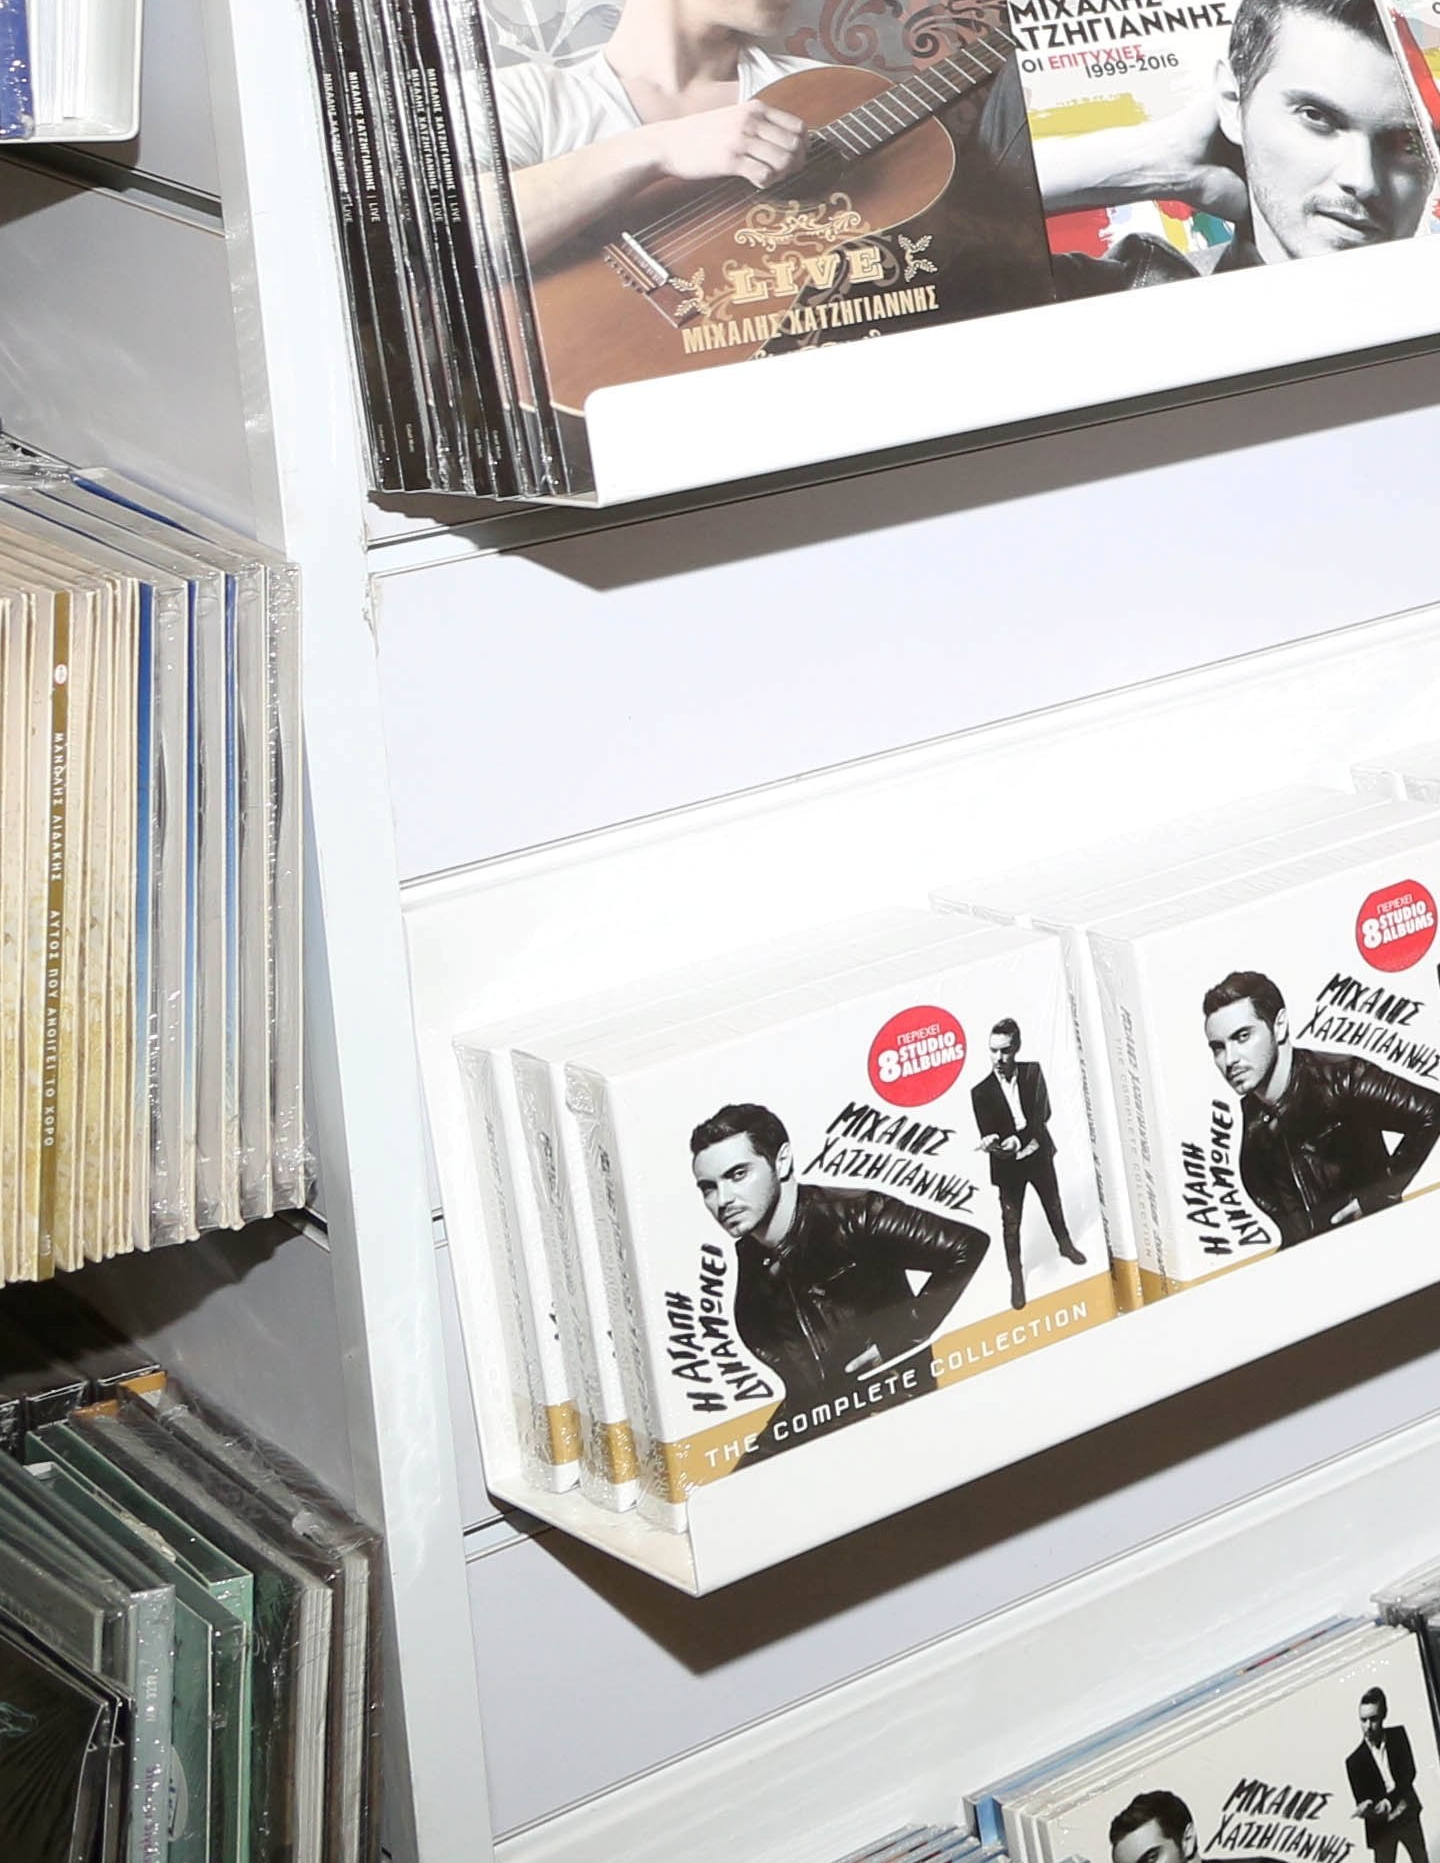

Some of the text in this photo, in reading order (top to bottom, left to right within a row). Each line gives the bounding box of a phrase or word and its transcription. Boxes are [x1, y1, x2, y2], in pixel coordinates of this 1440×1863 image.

[1021, 44, 1146, 74] ΟΙ ΕΠΙΤΥΧΙΕΣ
[1084, 53, 1180, 80] 1999-2016
[348, 71, 381, 223] ΜΙΧΑΛΗΣ ΧΑΤΖΗΓΙΑΝΝΗΣ LIVE
[410, 68, 444, 222] ΜΙΧΑΛΗΣ ΧΑΤΖΗΓΙΑΝΝΗΣ LIVE
[426, 68, 462, 223] ΜΙΧΑΛΗΣ ΧΑΤΖΗΓΙΑΝΝΗΣ LIVE
[729, 245, 884, 305] LIVE
[681, 285, 940, 355] ΜΙΧΑΛΗΣ ΧΑΤΖΗΓΙΑΝΝΗΣ
[41, 732, 66, 1147] ΜΑΝΩΛΗΣ ΛΙΔΑΚΗΣ ΑΥΤΟΣ ΠΟΥ ΑΝΟΙΓΕΙ ΤΟ ΧΟΡΟ
[1362, 901, 1427, 950] 8 STUDIO
[1382, 912, 1435, 944] ALBUMS
[876, 1032, 957, 1083] 8 STUDIO
[900, 1045, 965, 1078] ALBUMS
[1199, 1235, 1233, 1256] Η
[686, 1388, 728, 1413] Η
[705, 1301, 1089, 1469] THE COMPLETE COLLECTION
